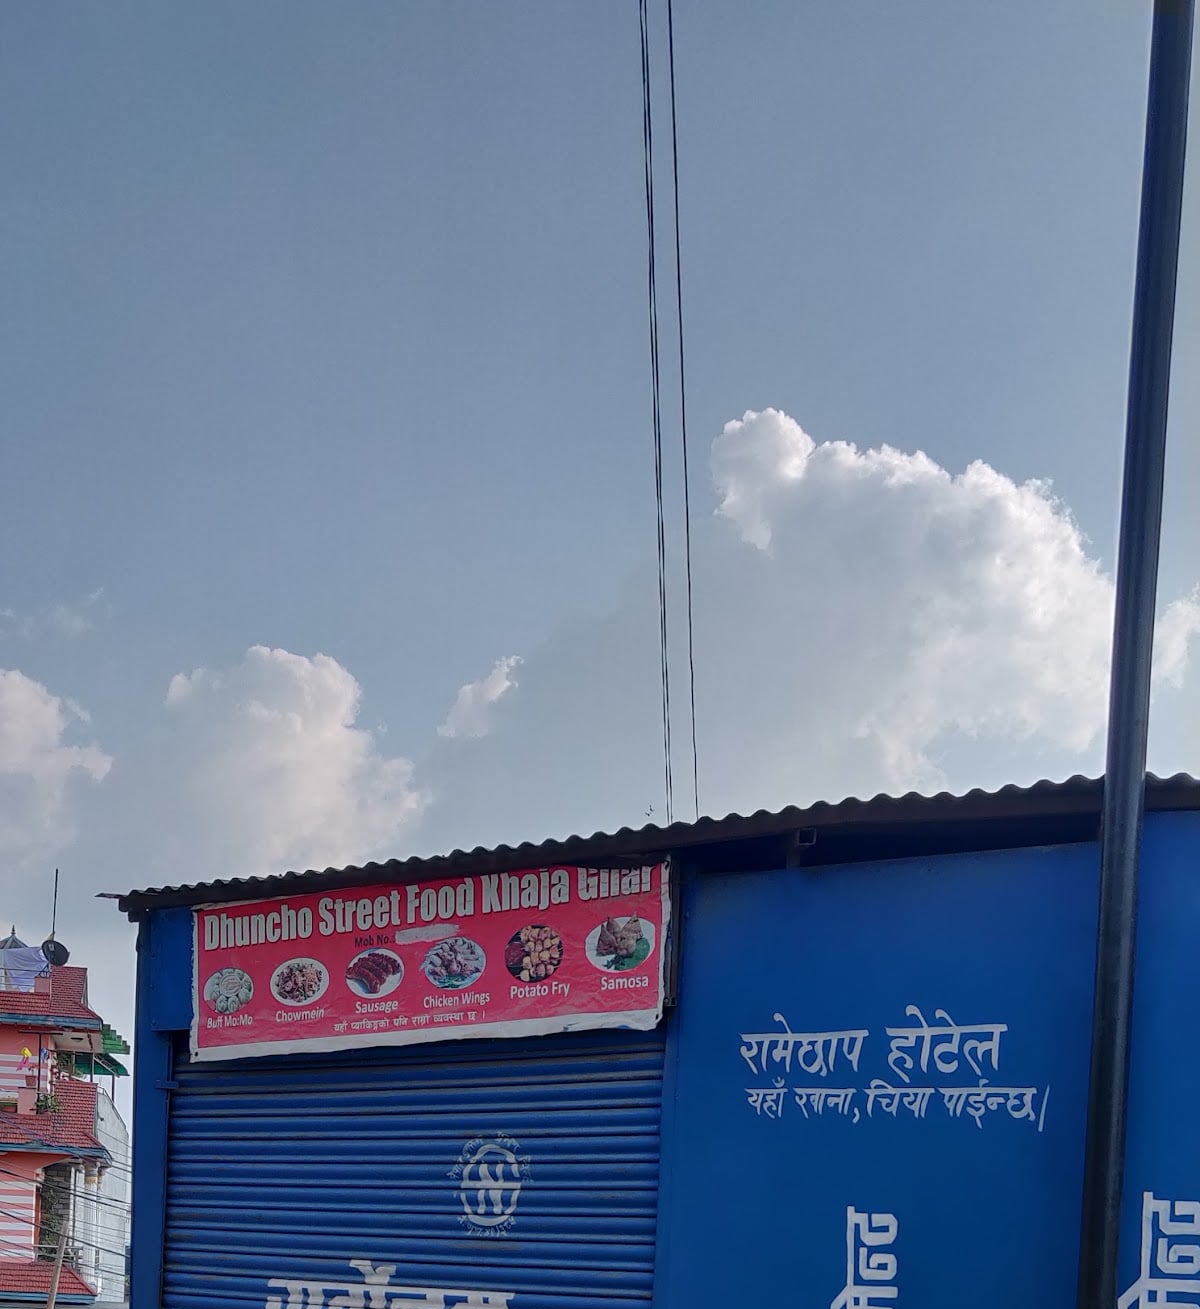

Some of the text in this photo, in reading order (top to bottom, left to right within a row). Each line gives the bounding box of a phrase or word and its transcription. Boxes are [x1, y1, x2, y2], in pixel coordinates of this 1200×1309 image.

[204, 904, 313, 950] Dhuncho
[318, 890, 401, 936] Street
[405, 878, 475, 924] Food
[480, 868, 570, 914] Khaja
[355, 935, 374, 947] Mob
[510, 981, 571, 999] Potato Fry
[601, 974, 649, 991] Samosa
[355, 1000, 399, 1014] Sausage
[423, 992, 490, 1009] Chicken Wings
[207, 1017, 223, 1029] Buff
[275, 1007, 325, 1022] Chowmein
[739, 1004, 1008, 1083] रामेछाप होटेल
[745, 1076, 788, 1119] यहाँ
[864, 1079, 935, 1119] चिया
